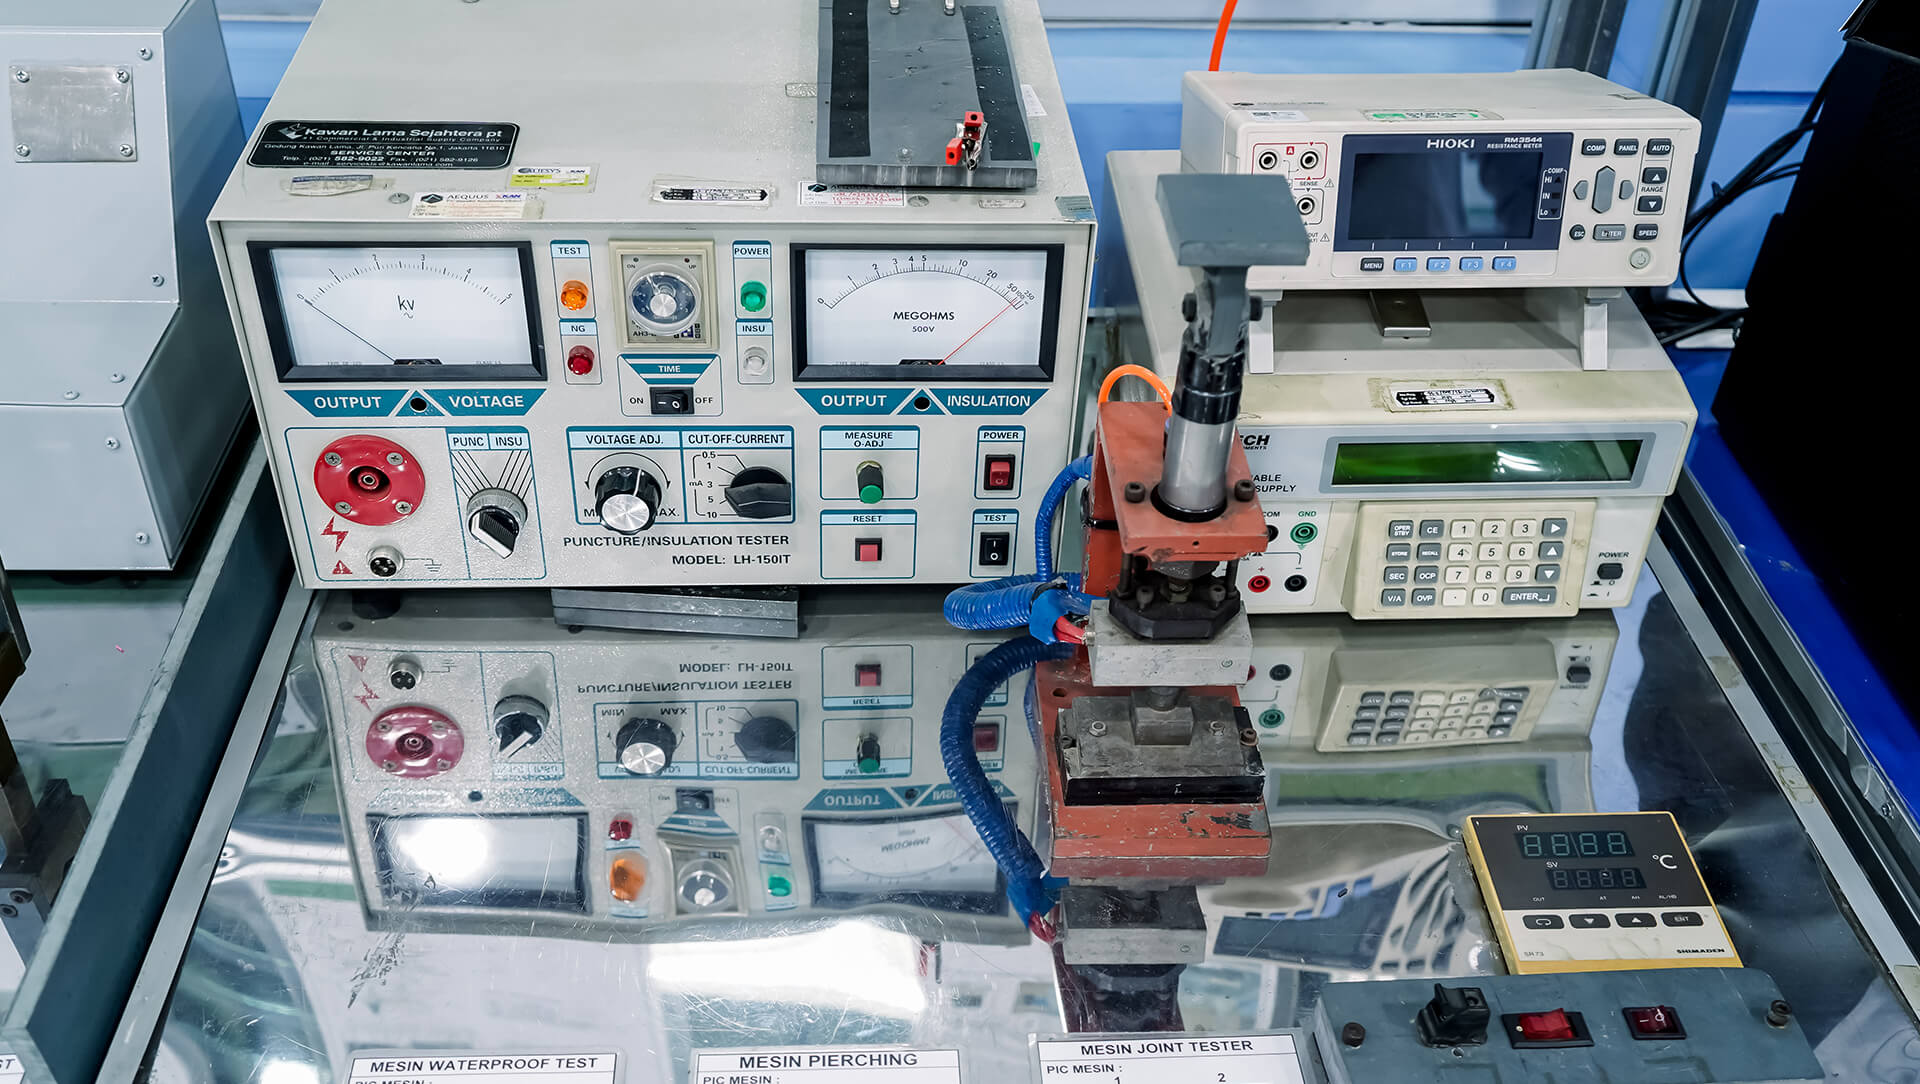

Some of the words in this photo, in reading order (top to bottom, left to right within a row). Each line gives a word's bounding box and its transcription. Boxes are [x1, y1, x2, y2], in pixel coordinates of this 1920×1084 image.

[305, 128, 359, 136] Kawan
[409, 129, 483, 138] Sejahtera
[486, 130, 503, 138] pt
[1426, 138, 1475, 149] HIOKI
[1586, 144, 1606, 152] COMP
[1652, 144, 1670, 152] AUTO
[1544, 176, 1552, 184] Hi
[558, 247, 582, 255] TEST
[734, 248, 769, 256] POWER
[1364, 262, 1382, 270] MENU
[958, 259, 968, 268] 10
[986, 270, 998, 279] 20
[1006, 282, 1018, 293] 50
[1024, 290, 1035, 301] 250
[893, 311, 955, 322] MEGOHMS
[570, 325, 586, 333] NG
[742, 325, 766, 333] INSU
[658, 365, 681, 373] TIME
[314, 396, 382, 409] OUTPUT
[448, 396, 524, 408] VOLTAGE
[821, 395, 888, 407] OUTPUT
[946, 395, 1031, 407] INSULATION
[586, 434, 636, 444] VOLTAGE
[639, 434, 664, 444] ADJ.
[688, 434, 785, 444] CUT-OFF-CURRENT
[844, 432, 894, 440] MEASURE
[983, 432, 1019, 440] POWER
[452, 437, 484, 447] PUNC
[495, 436, 522, 446] INSU
[702, 451, 716, 460] 0.5
[688, 480, 704, 488] mA
[707, 480, 714, 488] 3
[708, 496, 714, 504] 5
[707, 512, 718, 520] 10
[852, 514, 883, 522] RESET
[983, 514, 1008, 522] TEST
[1426, 526, 1438, 534] CE
[1461, 525, 1466, 534] 1
[1491, 524, 1498, 534] 2
[1522, 524, 1529, 534] 3
[563, 535, 733, 547] PUNCTURE/INSULATION
[736, 535, 790, 546] TESTER
[1457, 548, 1464, 556] 4
[1488, 548, 1496, 557] 5
[1518, 547, 1526, 556] 6
[672, 554, 726, 565] MODEL:
[1389, 572, 1405, 580] SEC
[1419, 572, 1436, 580] OCP
[1455, 571, 1462, 580] 7
[1485, 570, 1492, 580] 8
[1515, 570, 1522, 580] 9
[1388, 595, 1402, 603] V/A
[1416, 594, 1434, 602] OVP
[1482, 592, 1489, 602] 0
[1510, 592, 1538, 602] ENTER
[1516, 824, 1528, 832] PV
[1080, 1044, 1132, 1056] MESIN
[1137, 1042, 1184, 1054] JOINT
[1188, 1040, 1253, 1052] TESTER
[370, 1061, 424, 1073] MESIN
[429, 1058, 550, 1071] WATERPROOF
[554, 1057, 598, 1069] TEST
[739, 1055, 802, 1069] MESIN
[808, 1053, 918, 1068] PIERCHING
[1046, 1065, 1069, 1074] PIC
[1072, 1064, 1115, 1074] MESIN
[702, 1076, 726, 1084] PIC
[729, 1075, 772, 1084] MESIN
[1217, 1072, 1226, 1083] 2
